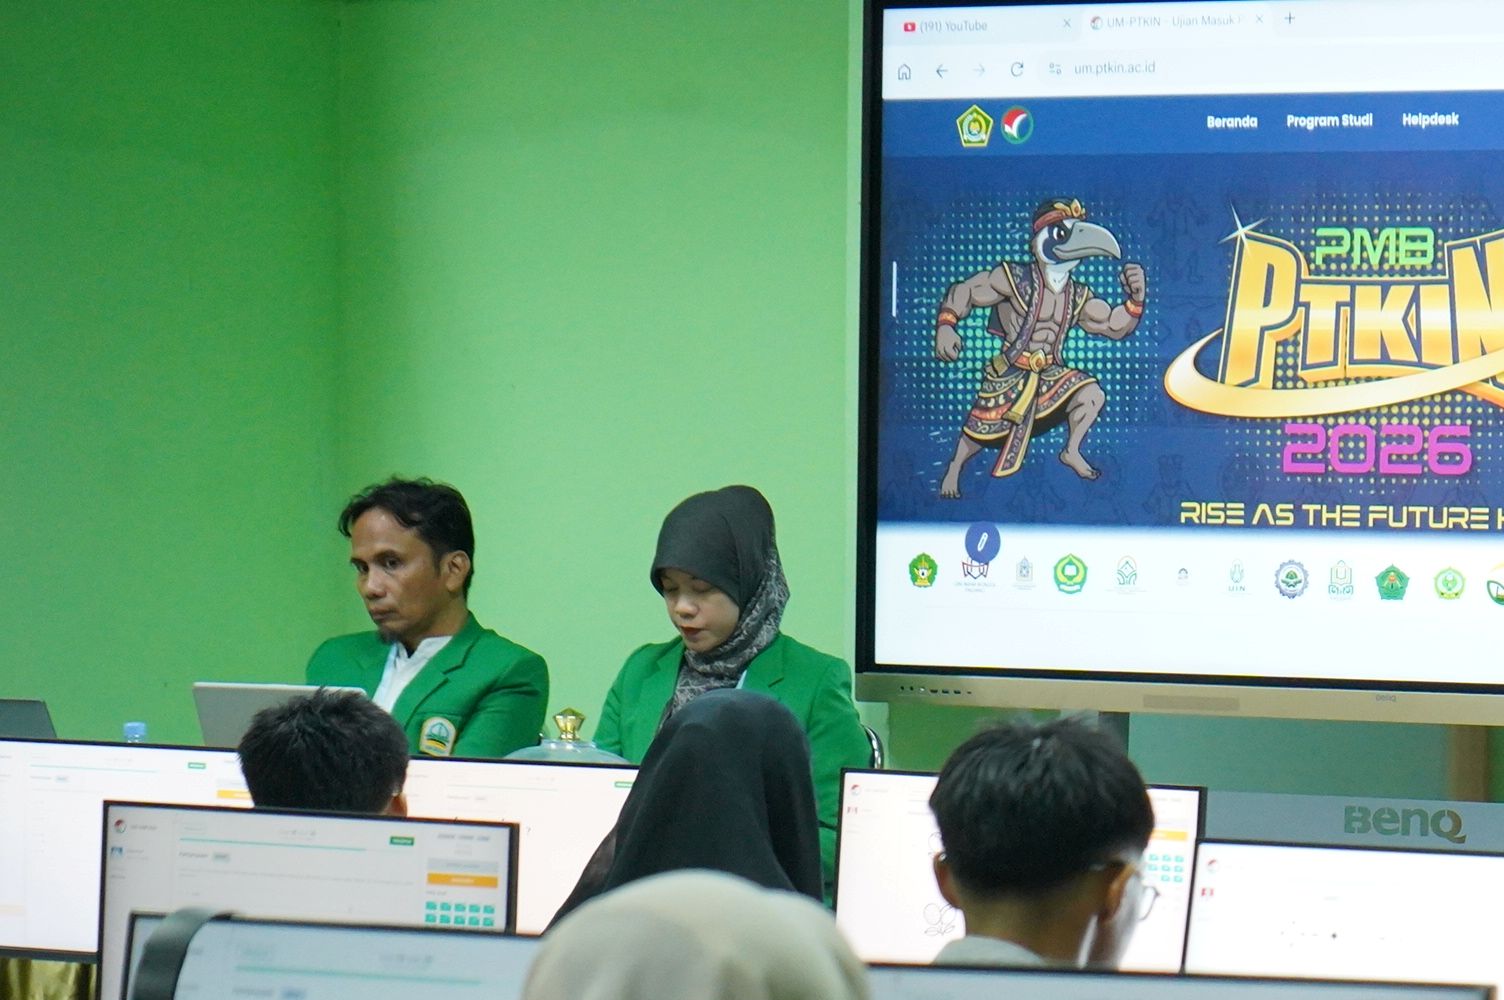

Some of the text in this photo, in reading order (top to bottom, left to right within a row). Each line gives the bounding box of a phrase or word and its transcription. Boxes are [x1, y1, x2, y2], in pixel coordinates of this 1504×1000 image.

[945, 20, 988, 32] YouTube
[1106, 16, 1161, 28] UM-PTKIN
[1172, 15, 1198, 28] Ujian
[1201, 13, 1235, 26] Masuk
[1074, 60, 1156, 76] um.ptkin.ac.id
[1207, 115, 1258, 128] Beranda
[1287, 113, 1373, 130] Program Studi
[1402, 112, 1459, 128] Helpdesk
[1315, 227, 1436, 266] PMB
[1282, 424, 1474, 475] 2026
[1180, 502, 1245, 525] RISE
[1251, 503, 1295, 526] AS
[1302, 504, 1361, 527] THE
[1368, 505, 1490, 530] FUTURE
[1344, 805, 1467, 844] BenQ
